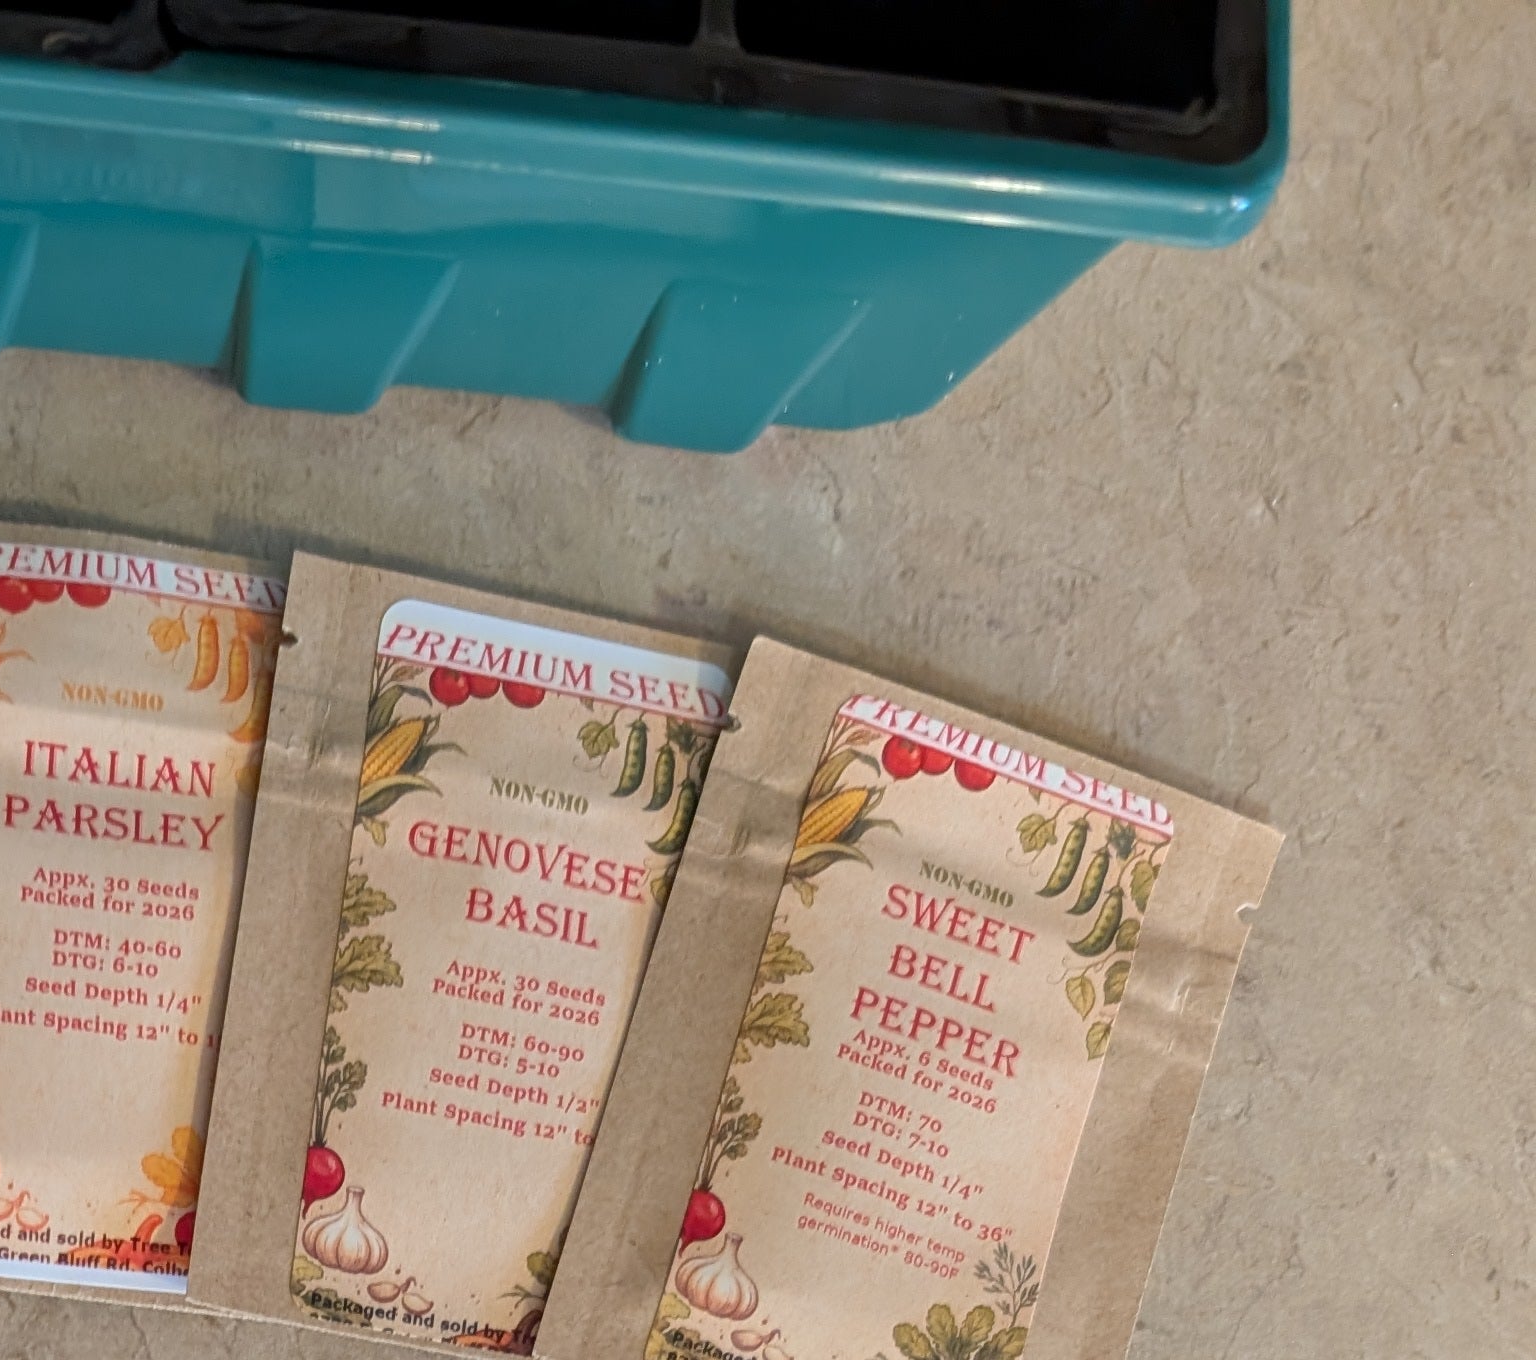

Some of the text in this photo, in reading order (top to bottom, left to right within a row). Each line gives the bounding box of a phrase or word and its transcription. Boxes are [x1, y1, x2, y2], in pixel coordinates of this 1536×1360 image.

[61, 682, 164, 713] NON-GMO
[384, 624, 734, 725] PREMIUM SEED
[24, 740, 216, 798] ITALIAN
[4, 793, 225, 851] PARSLEY
[489, 776, 589, 816] NON-GMO
[33, 866, 200, 901] Appx. 30 Seeds
[408, 820, 649, 903] GENOVESE
[919, 859, 1014, 908] NON-GMO
[53, 928, 182, 960] DTM: 40-60
[465, 887, 598, 949] BASIL
[881, 884, 1035, 965] SWEET
[25, 977, 76, 997] Seed
[85, 982, 148, 1008] Depth
[432, 978, 600, 1027] Packed for 2026
[887, 944, 994, 1013] BELL
[461, 1023, 585, 1062] DTM: 60-90
[849, 986, 1020, 1078] PEPPER
[457, 1043, 560, 1079] DTG: 5-10
[858, 1091, 943, 1134] DTM: 70
[771, 1146, 827, 1177] Plant
[831, 1167, 911, 1211] Spacing
[953, 1211, 974, 1231] to
[803, 1191, 966, 1265] Requires higher temp
